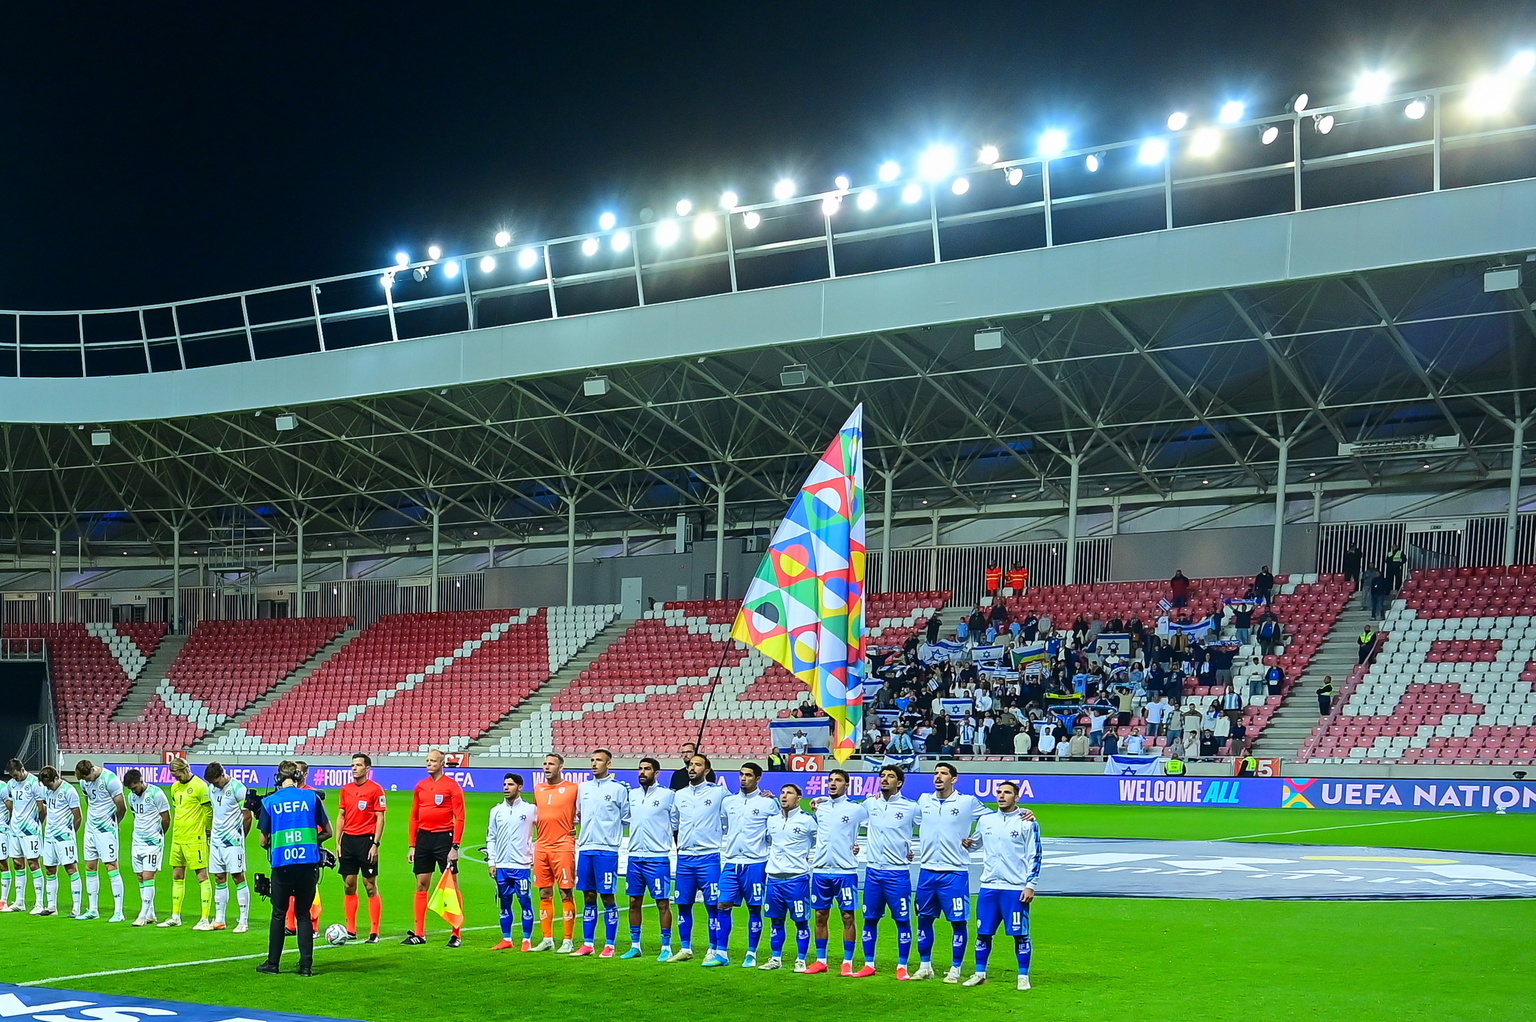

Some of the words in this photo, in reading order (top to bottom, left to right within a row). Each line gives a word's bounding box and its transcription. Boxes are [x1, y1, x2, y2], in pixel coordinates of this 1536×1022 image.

[791, 756, 818, 772] C6
[1120, 780, 1203, 803] WELCOME
[1203, 780, 1240, 803] ALL
[1321, 784, 1402, 806] UEFA
[216, 796, 222, 807] 4
[136, 804, 144, 814] 18
[273, 801, 310, 815] UEFA
[285, 831, 302, 844] HB
[1, 842, 7, 852] 6
[30, 840, 39, 851] 12
[64, 846, 75, 857] 14
[108, 844, 115, 854] 5
[148, 854, 157, 865] 18
[237, 853, 243, 865] 4
[283, 847, 306, 861] 002
[561, 868, 567, 880] 1
[604, 872, 613, 884] 13
[519, 879, 528, 891] 10
[710, 883, 718, 895] 15
[752, 883, 762, 895] 17
[842, 887, 852, 901] 14
[794, 900, 803, 912] 16
[900, 898, 907, 911] 3
[952, 897, 963, 911] 19
[1012, 911, 1021, 925] 11
